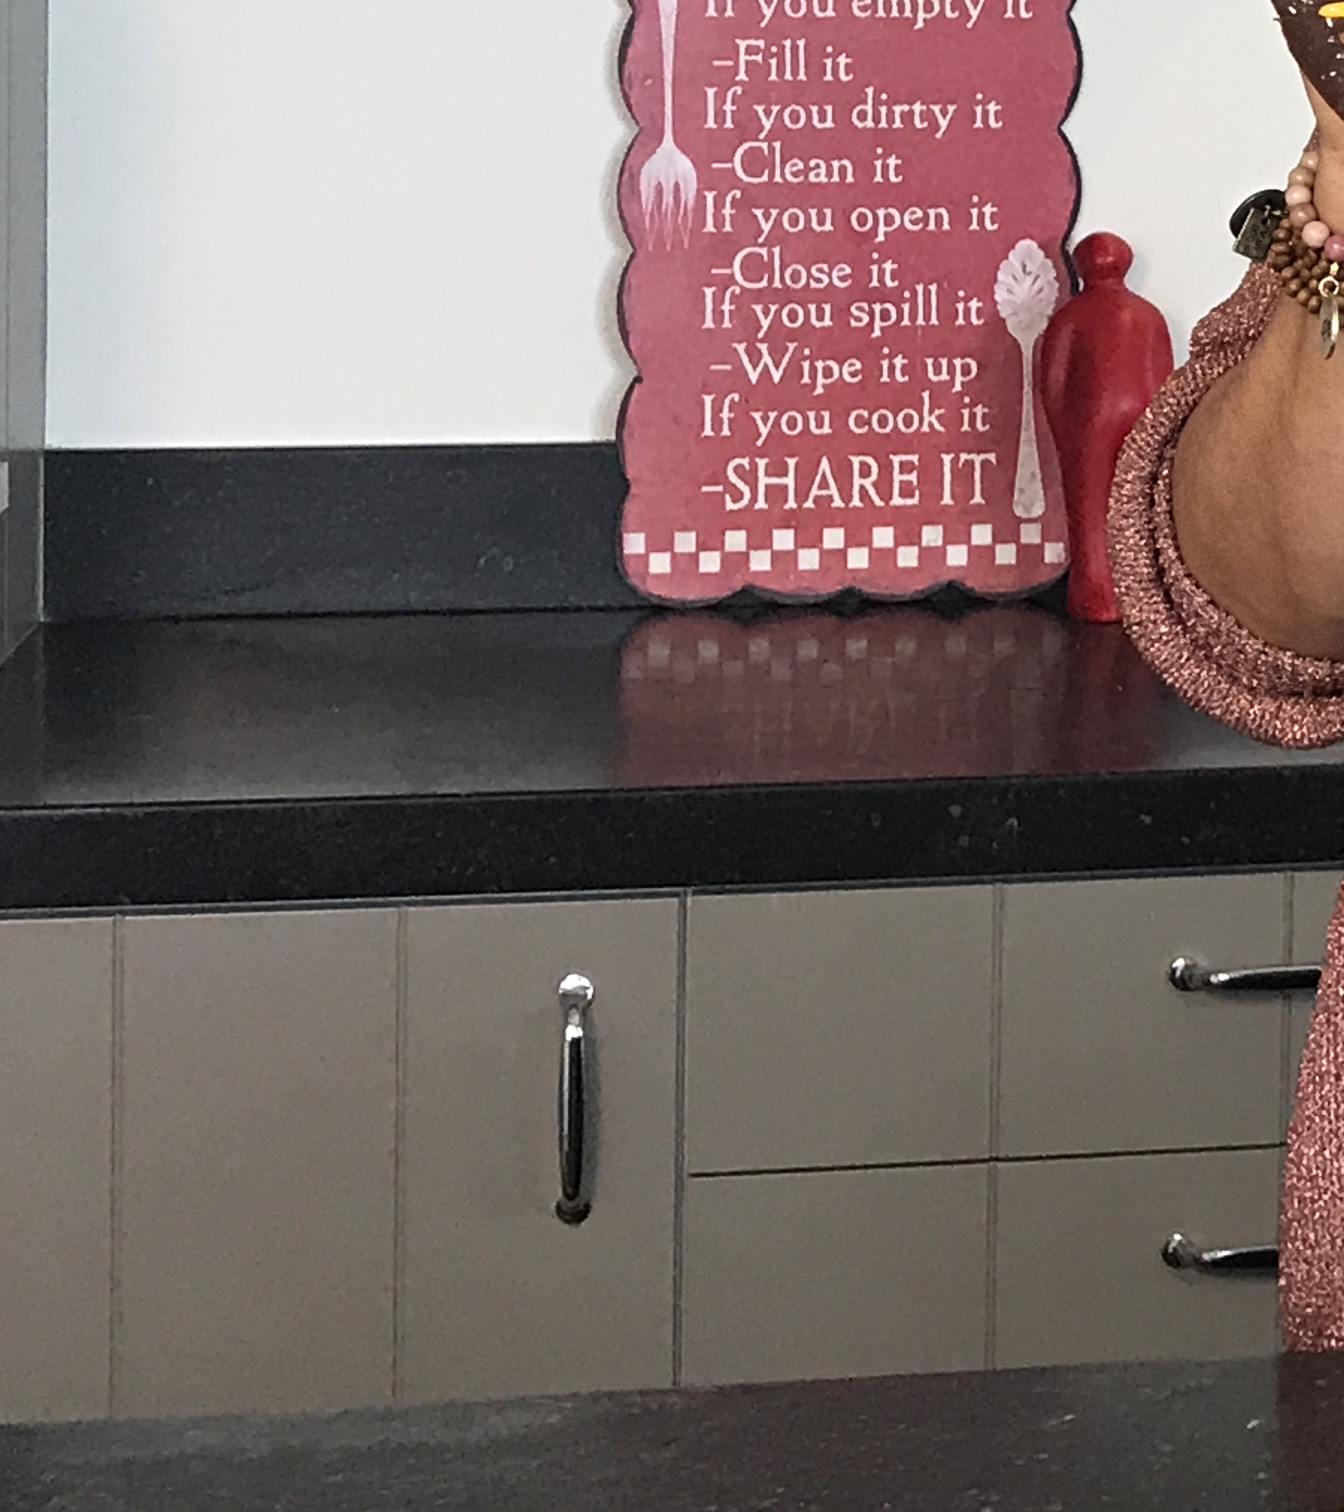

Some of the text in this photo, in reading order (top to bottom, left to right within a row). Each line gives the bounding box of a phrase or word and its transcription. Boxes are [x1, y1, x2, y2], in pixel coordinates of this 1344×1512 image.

[823, 45, 853, 82] it
[703, 85, 1003, 139] If you dirty it
[873, 147, 903, 183] it
[702, 189, 999, 243] If you open it
[869, 252, 899, 288] it
[702, 282, 985, 338] If you spill it
[879, 347, 910, 383] it
[925, 356, 979, 394] up
[700, 390, 991, 447] If you cook it
[940, 452, 997, 506] IT
